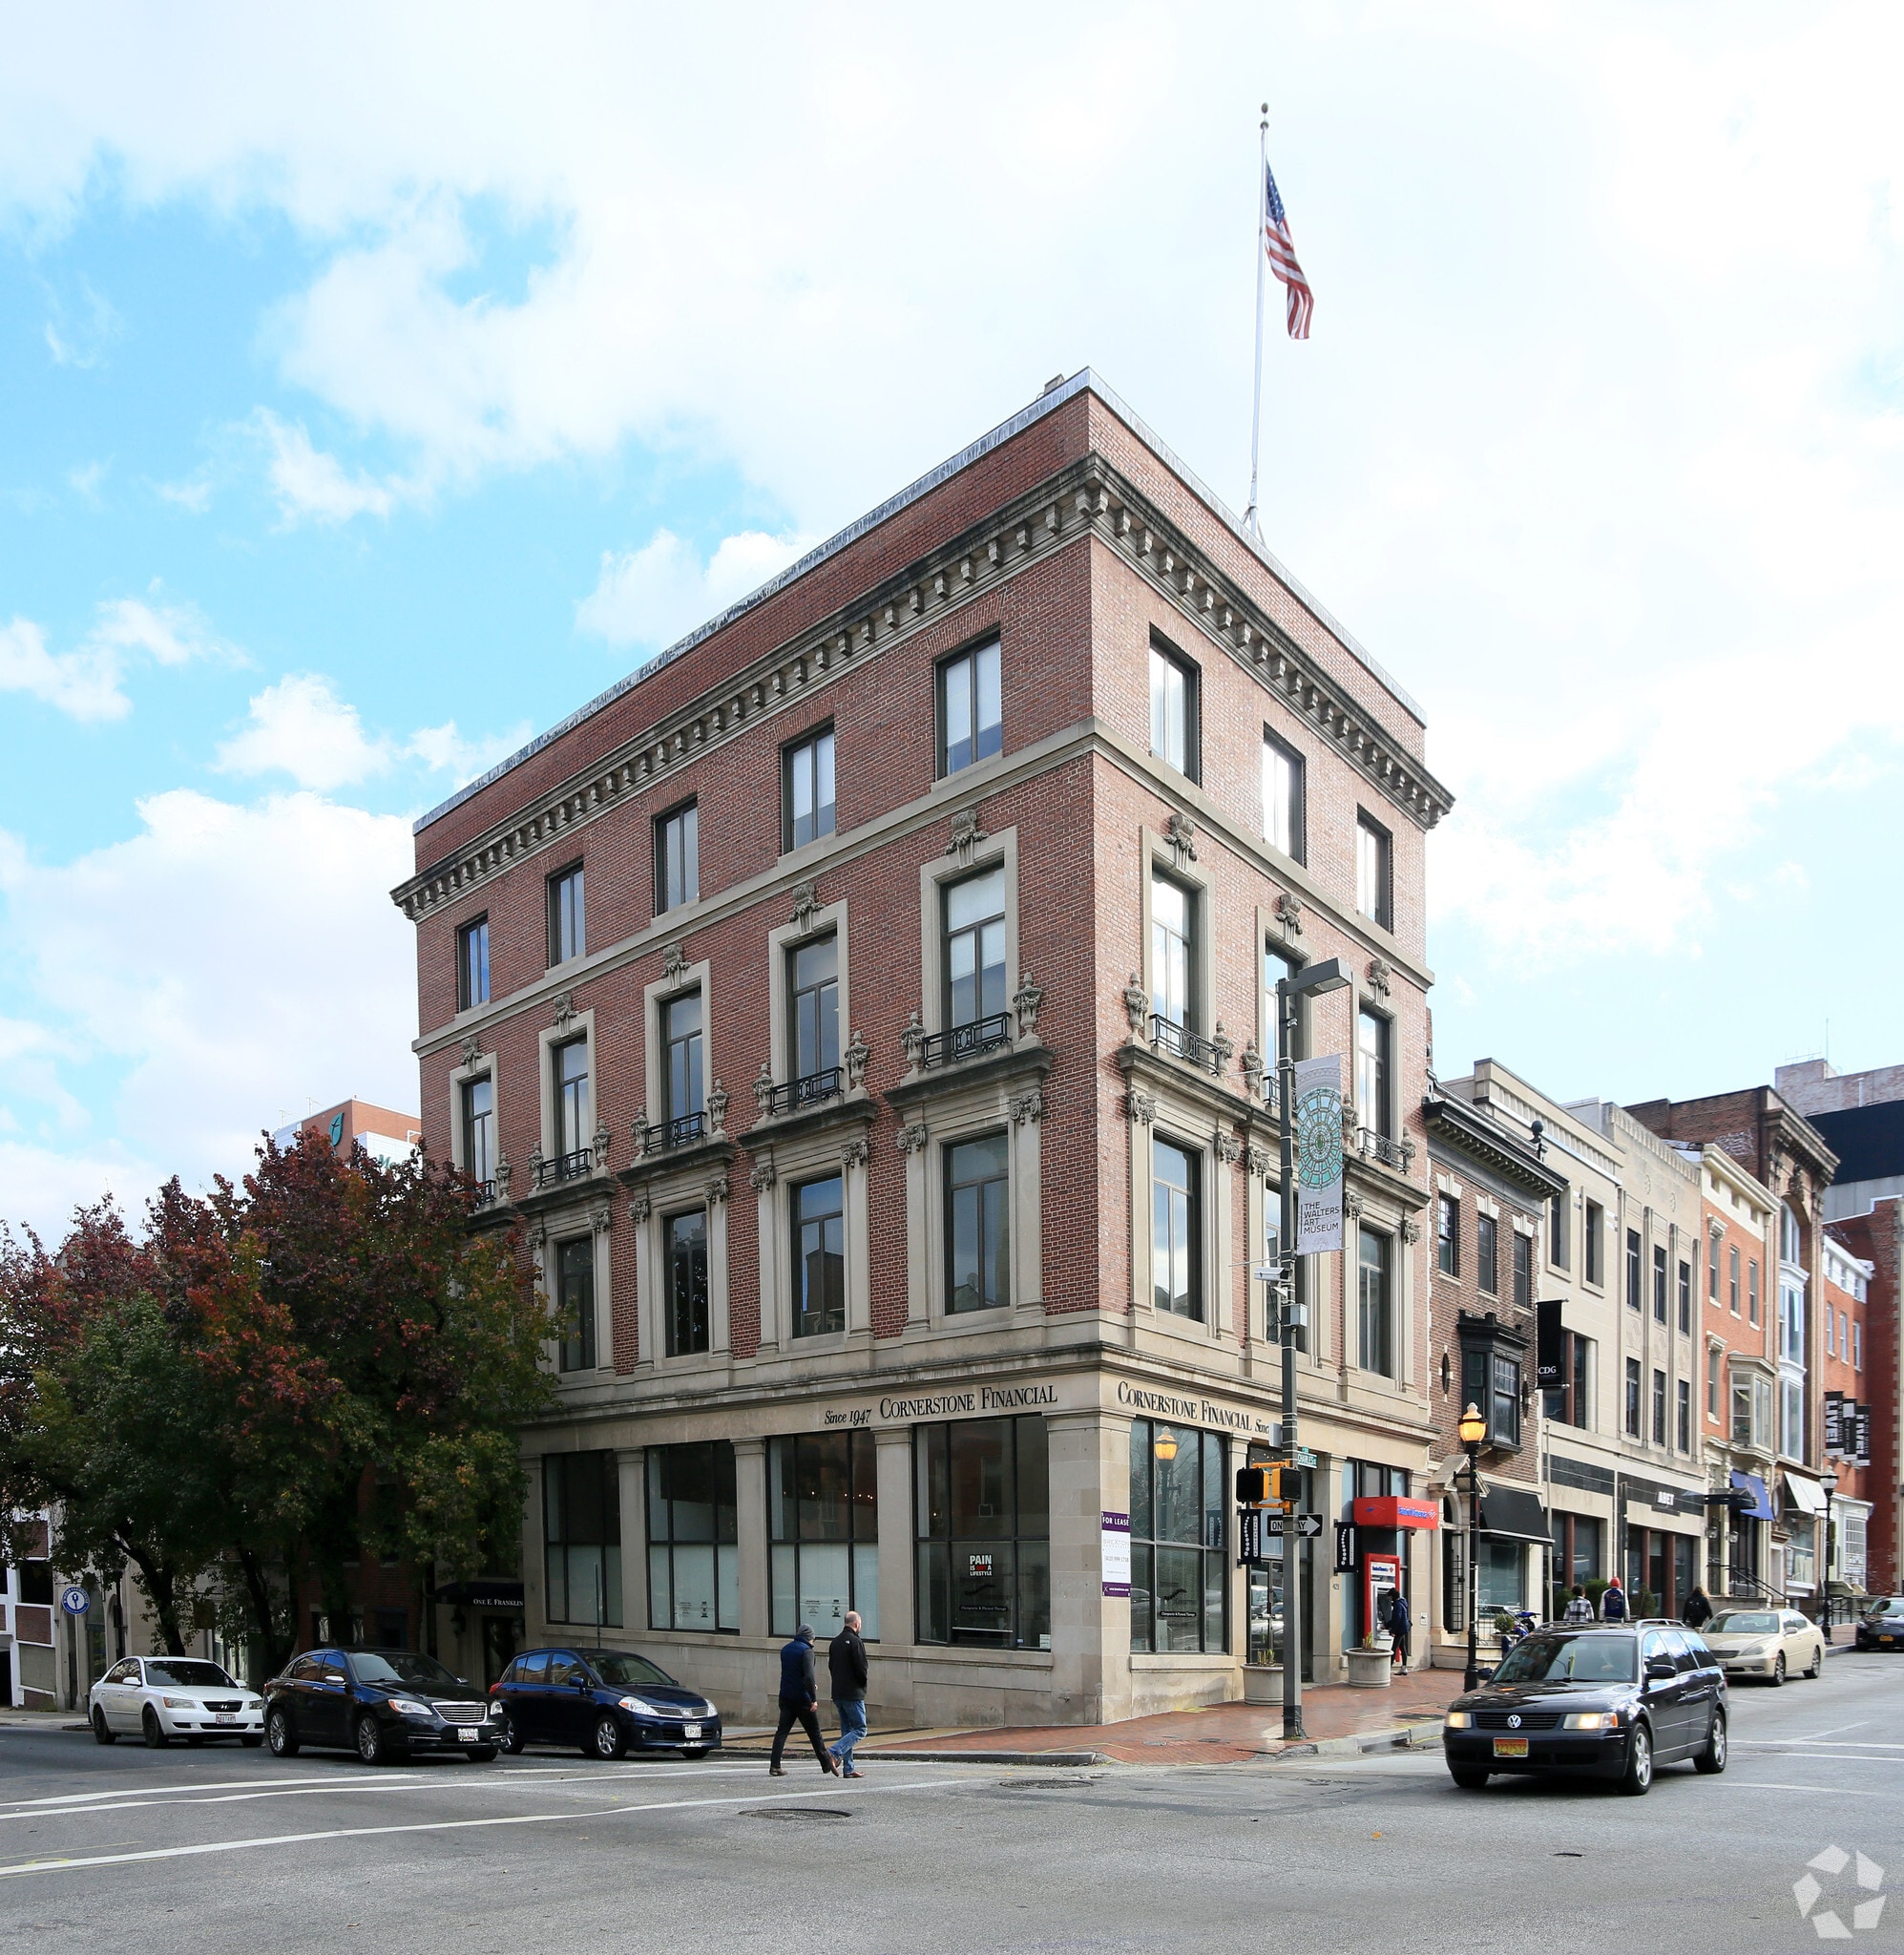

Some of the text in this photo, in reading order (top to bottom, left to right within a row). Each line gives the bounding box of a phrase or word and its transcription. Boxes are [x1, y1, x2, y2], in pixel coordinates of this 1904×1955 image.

[1304, 1201, 1321, 1210] THE
[1304, 1206, 1340, 1219] WALTERS
[1304, 1217, 1320, 1227] ART
[1304, 1222, 1339, 1234] MUSEUM
[1538, 1365, 1557, 1375] CDG
[824, 1385, 1058, 1426] Since 1947 CORNERSTONE FINANCIAL
[1118, 1380, 1269, 1435] CORNERSTONE FINANCIAL Sinc
[1102, 1516, 1130, 1526] FOR LEASE
[1271, 1521, 1284, 1530] ON
[970, 1555, 993, 1565] PAIN
